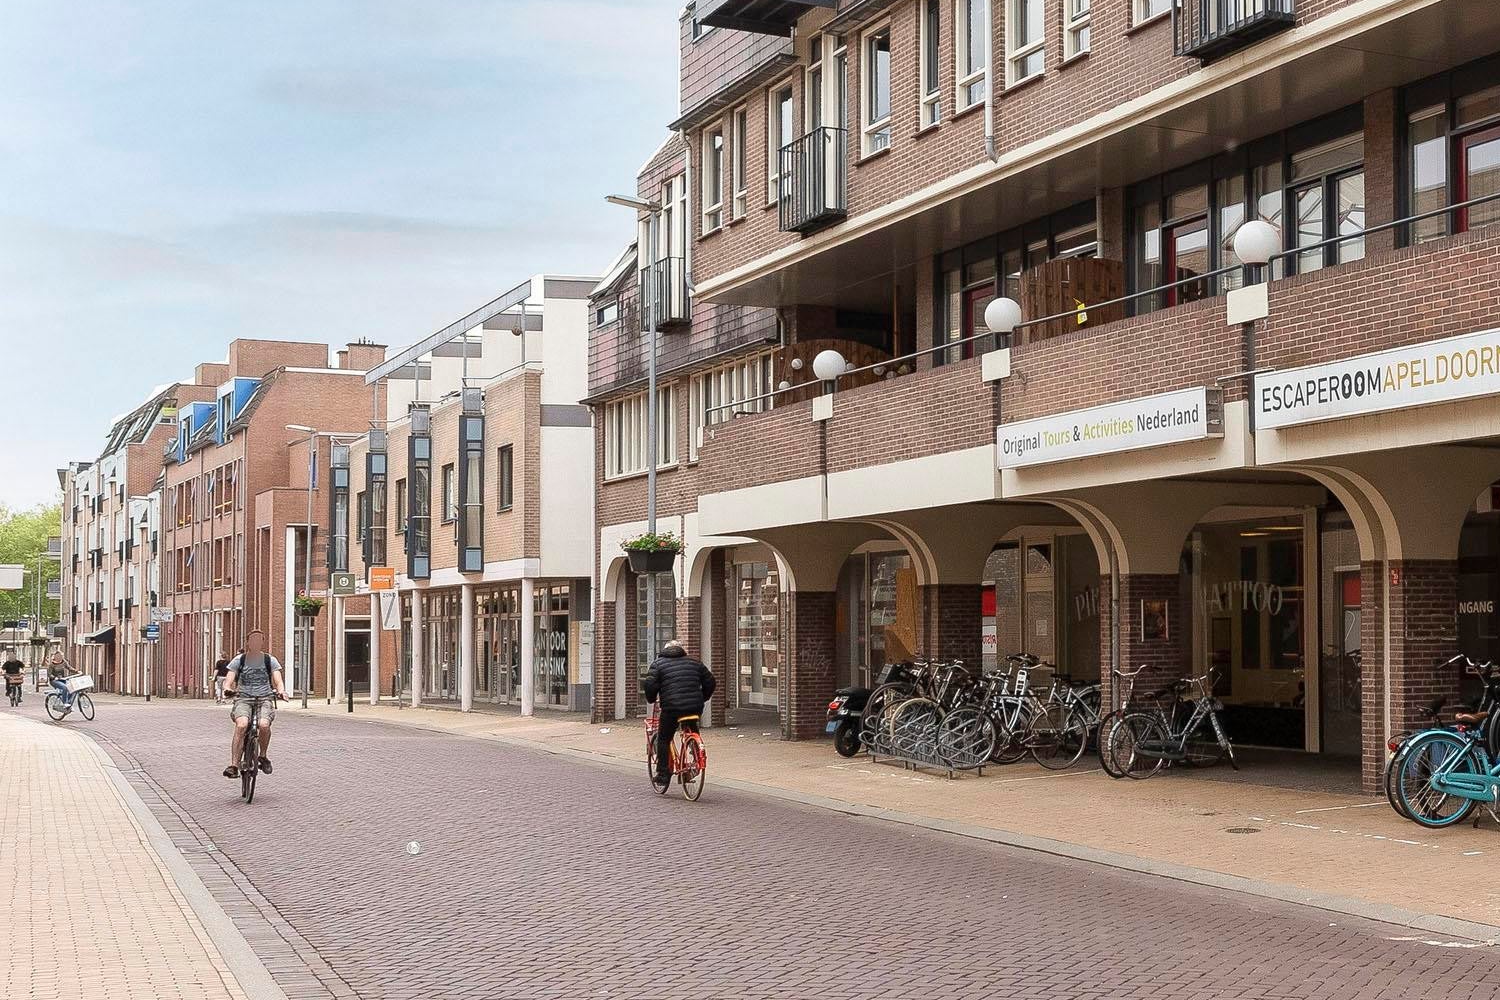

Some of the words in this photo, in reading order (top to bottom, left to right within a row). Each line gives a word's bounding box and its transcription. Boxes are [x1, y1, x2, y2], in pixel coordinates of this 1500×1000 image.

[1003, 431, 1041, 457] Original
[1042, 430, 1070, 447] Tours
[1073, 425, 1081, 442] &
[1083, 416, 1134, 441] Activities
[1136, 403, 1199, 432] Nederland
